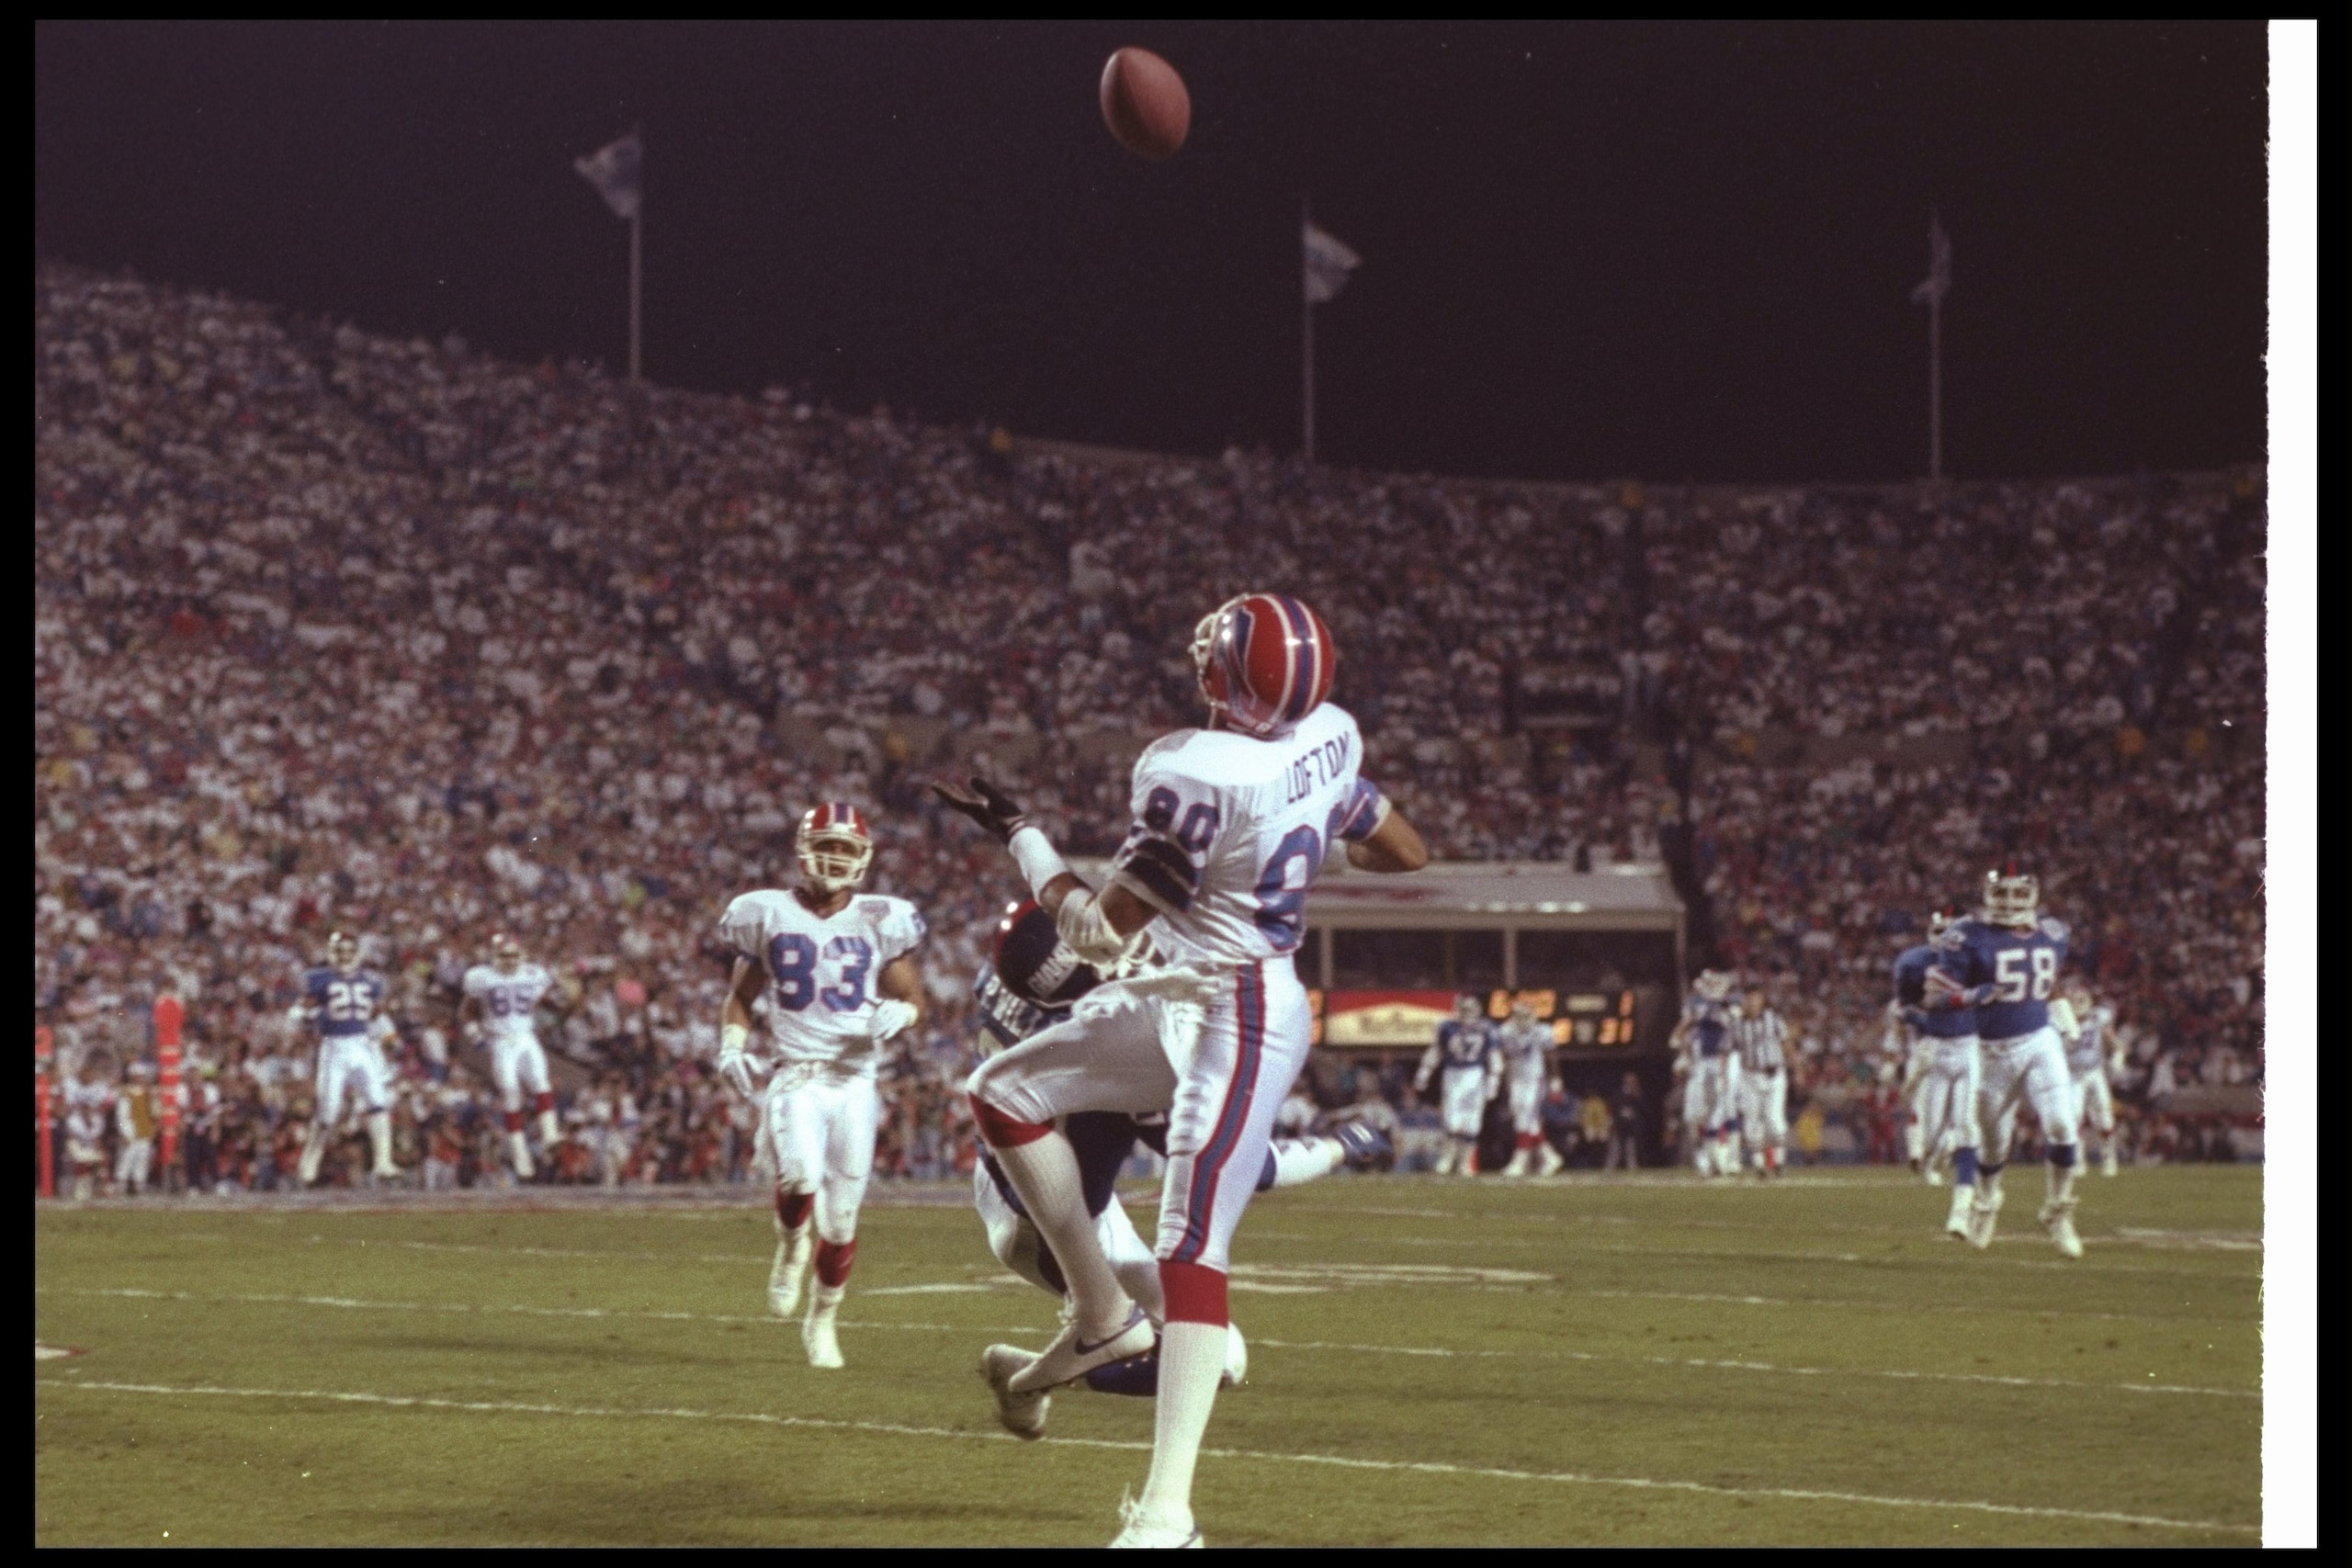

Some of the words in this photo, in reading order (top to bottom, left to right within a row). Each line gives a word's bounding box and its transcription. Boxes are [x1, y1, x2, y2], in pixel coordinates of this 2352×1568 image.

[1285, 730, 1350, 805] LOFTON
[1144, 784, 1220, 854] 80
[326, 980, 374, 1021] 25
[768, 931, 873, 1012] 83
[1995, 946, 2058, 1003] 58
